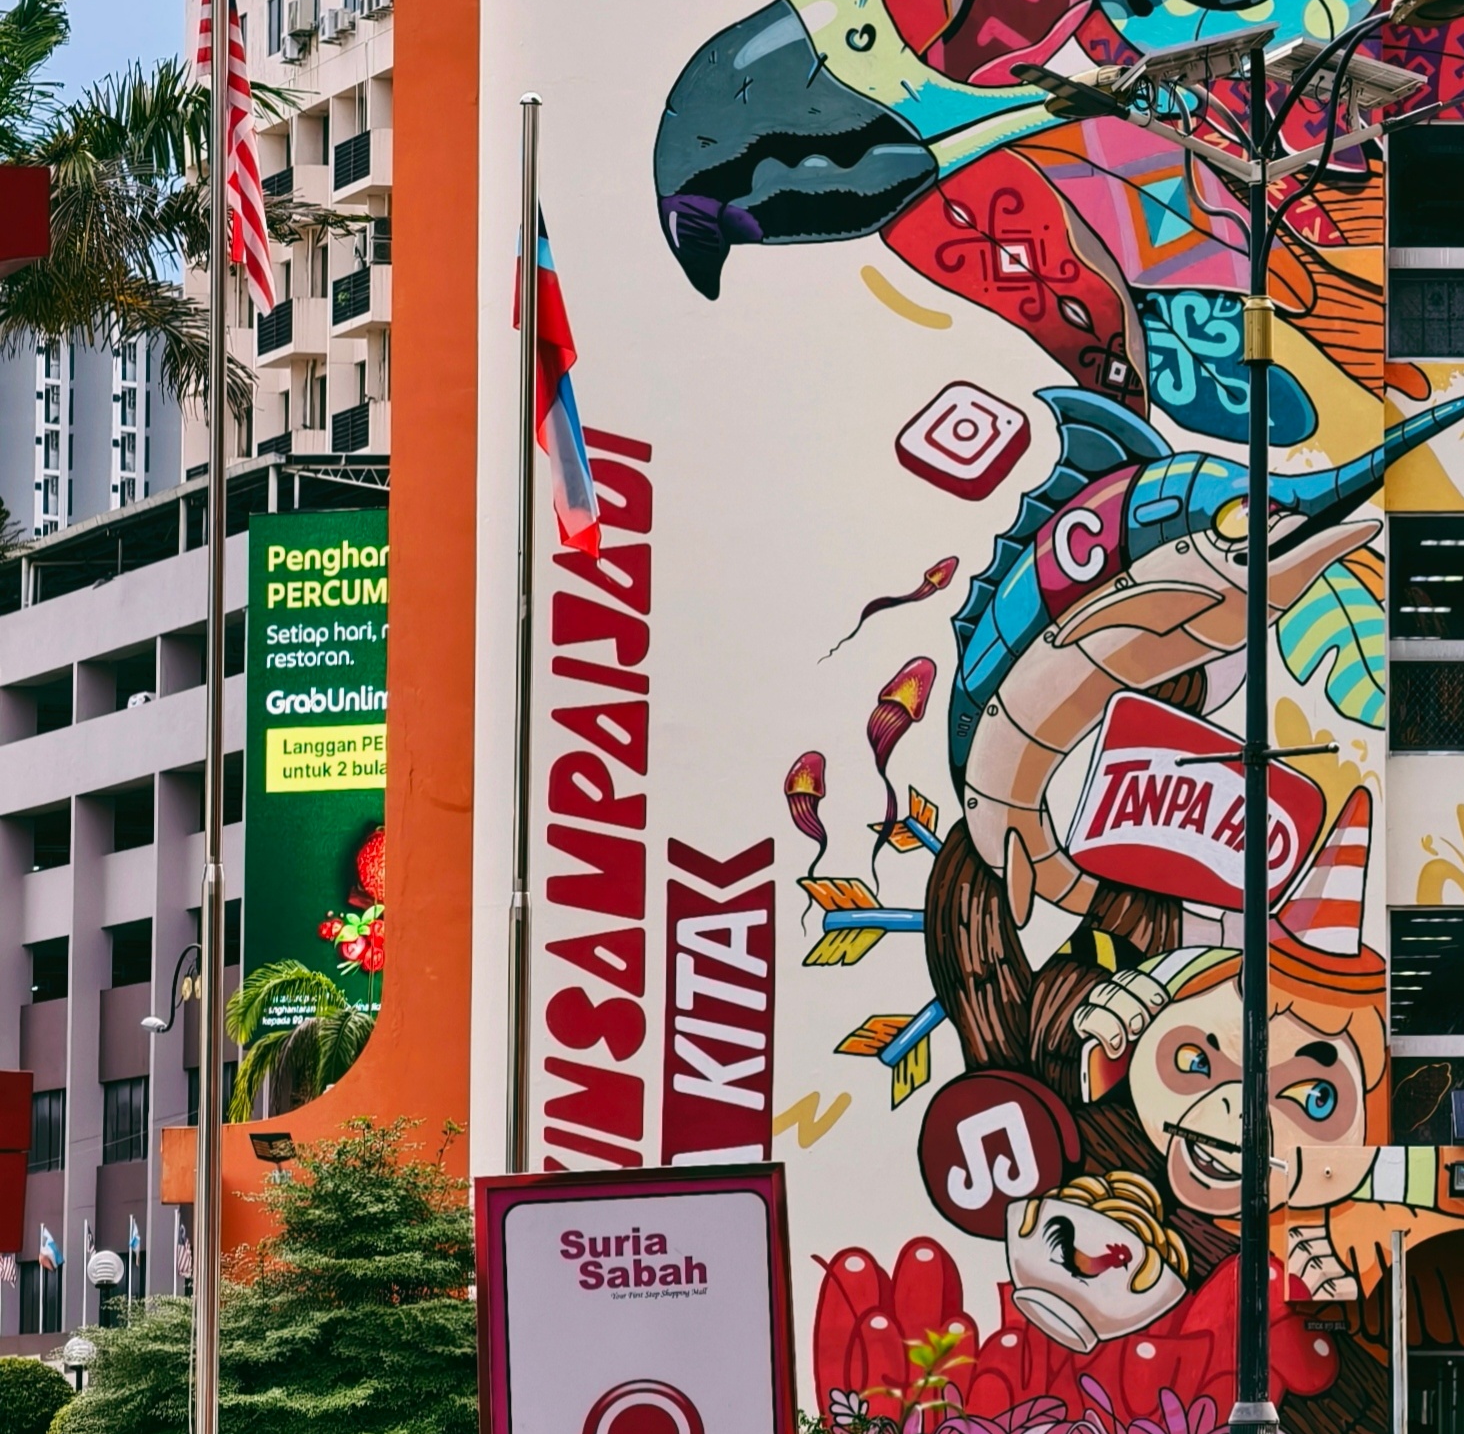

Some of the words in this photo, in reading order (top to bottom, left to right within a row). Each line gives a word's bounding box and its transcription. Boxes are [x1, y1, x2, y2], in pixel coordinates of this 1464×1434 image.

[267, 577, 389, 608] PERCUM
[266, 624, 329, 647] Setiap
[333, 621, 377, 642] hari,
[266, 650, 355, 668] restoran.
[283, 737, 357, 757] Langgan
[282, 761, 331, 779] untuk
[337, 761, 347, 776] 2
[1084, 759, 1214, 841] TANPA
[1211, 794, 1291, 871] HD
[673, 909, 768, 1111] KITA
[560, 1227, 668, 1260] Suria
[579, 1256, 708, 1290] Sabah
